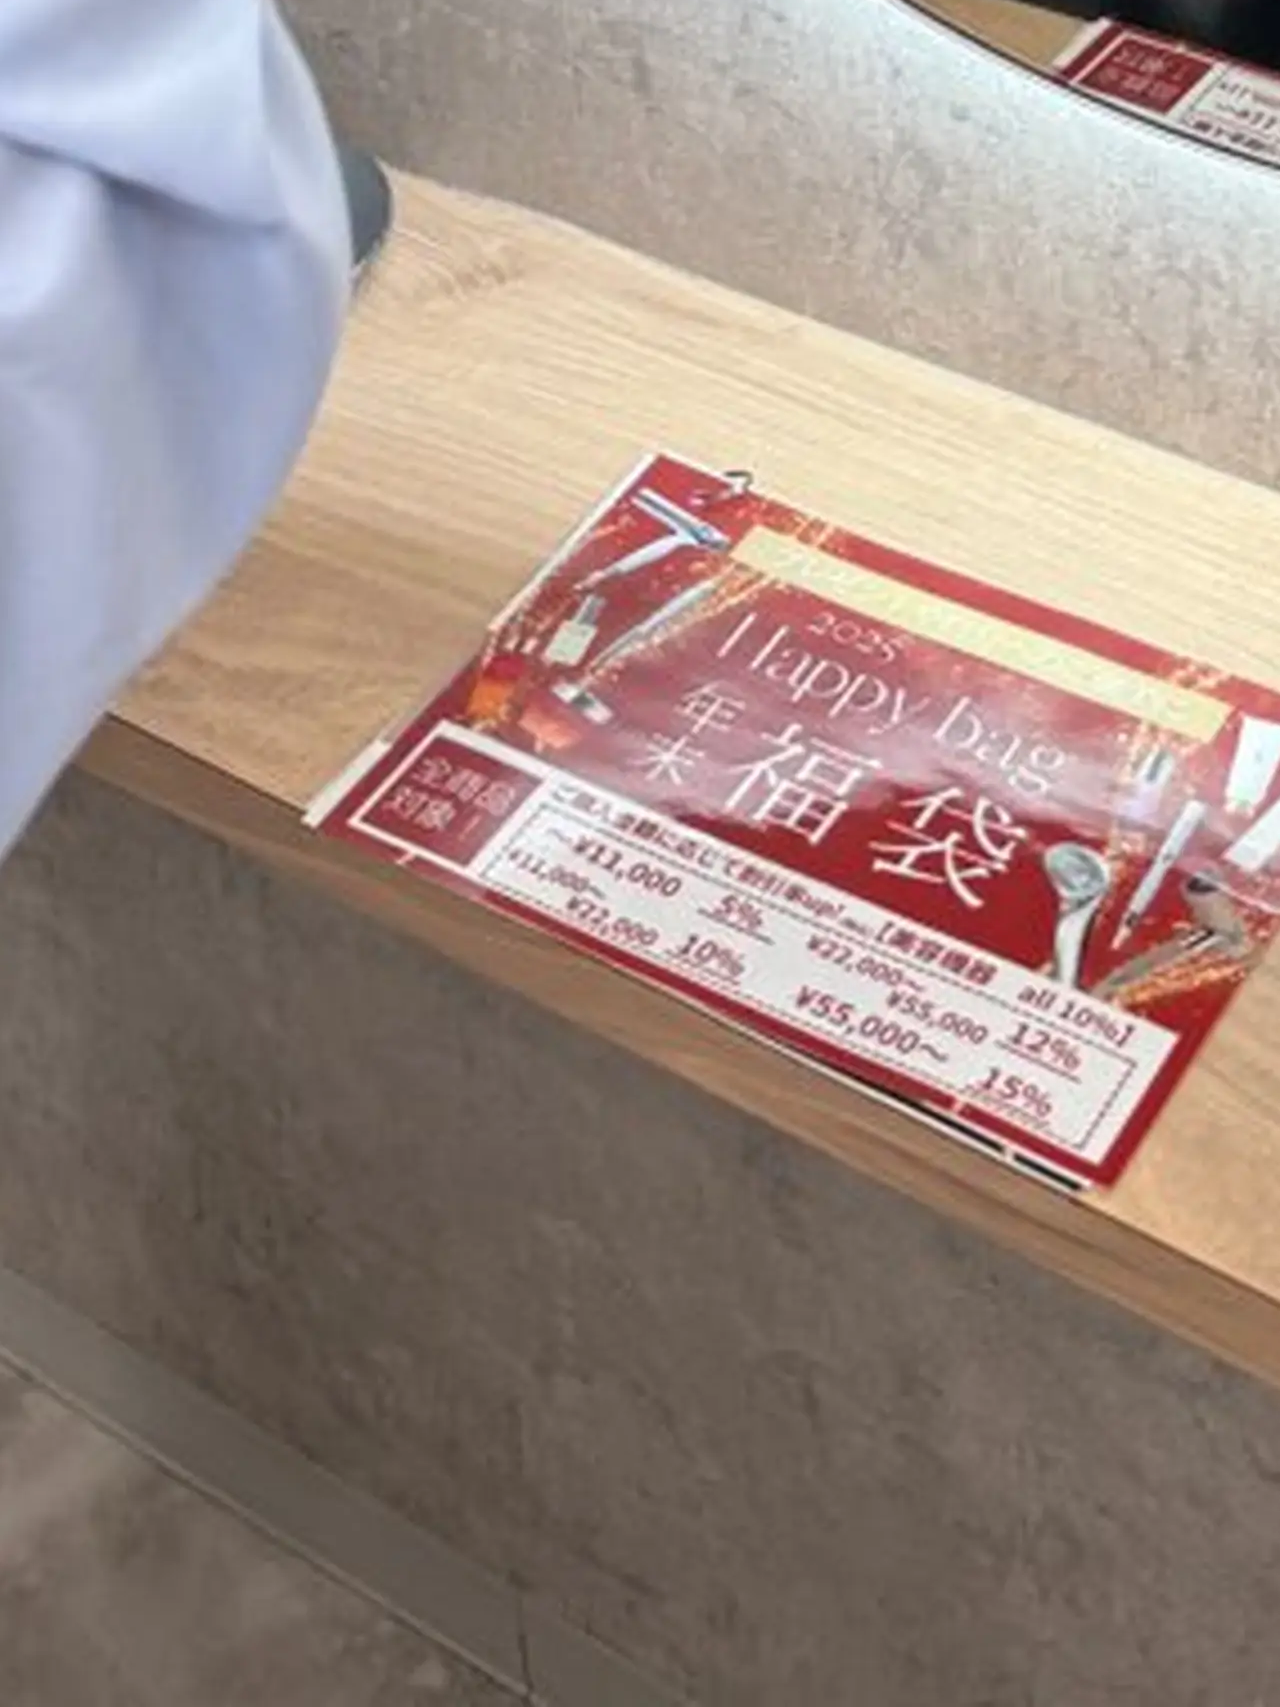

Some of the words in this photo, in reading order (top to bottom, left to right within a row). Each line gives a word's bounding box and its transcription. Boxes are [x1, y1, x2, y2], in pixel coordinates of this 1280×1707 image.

[805, 610, 916, 663] 2025
[717, 612, 928, 734] Happy
[933, 696, 1074, 795] bag
[677, 934, 746, 978] 10%
[1010, 1023, 1082, 1071] 12%
[982, 1067, 1054, 1117] 15%
